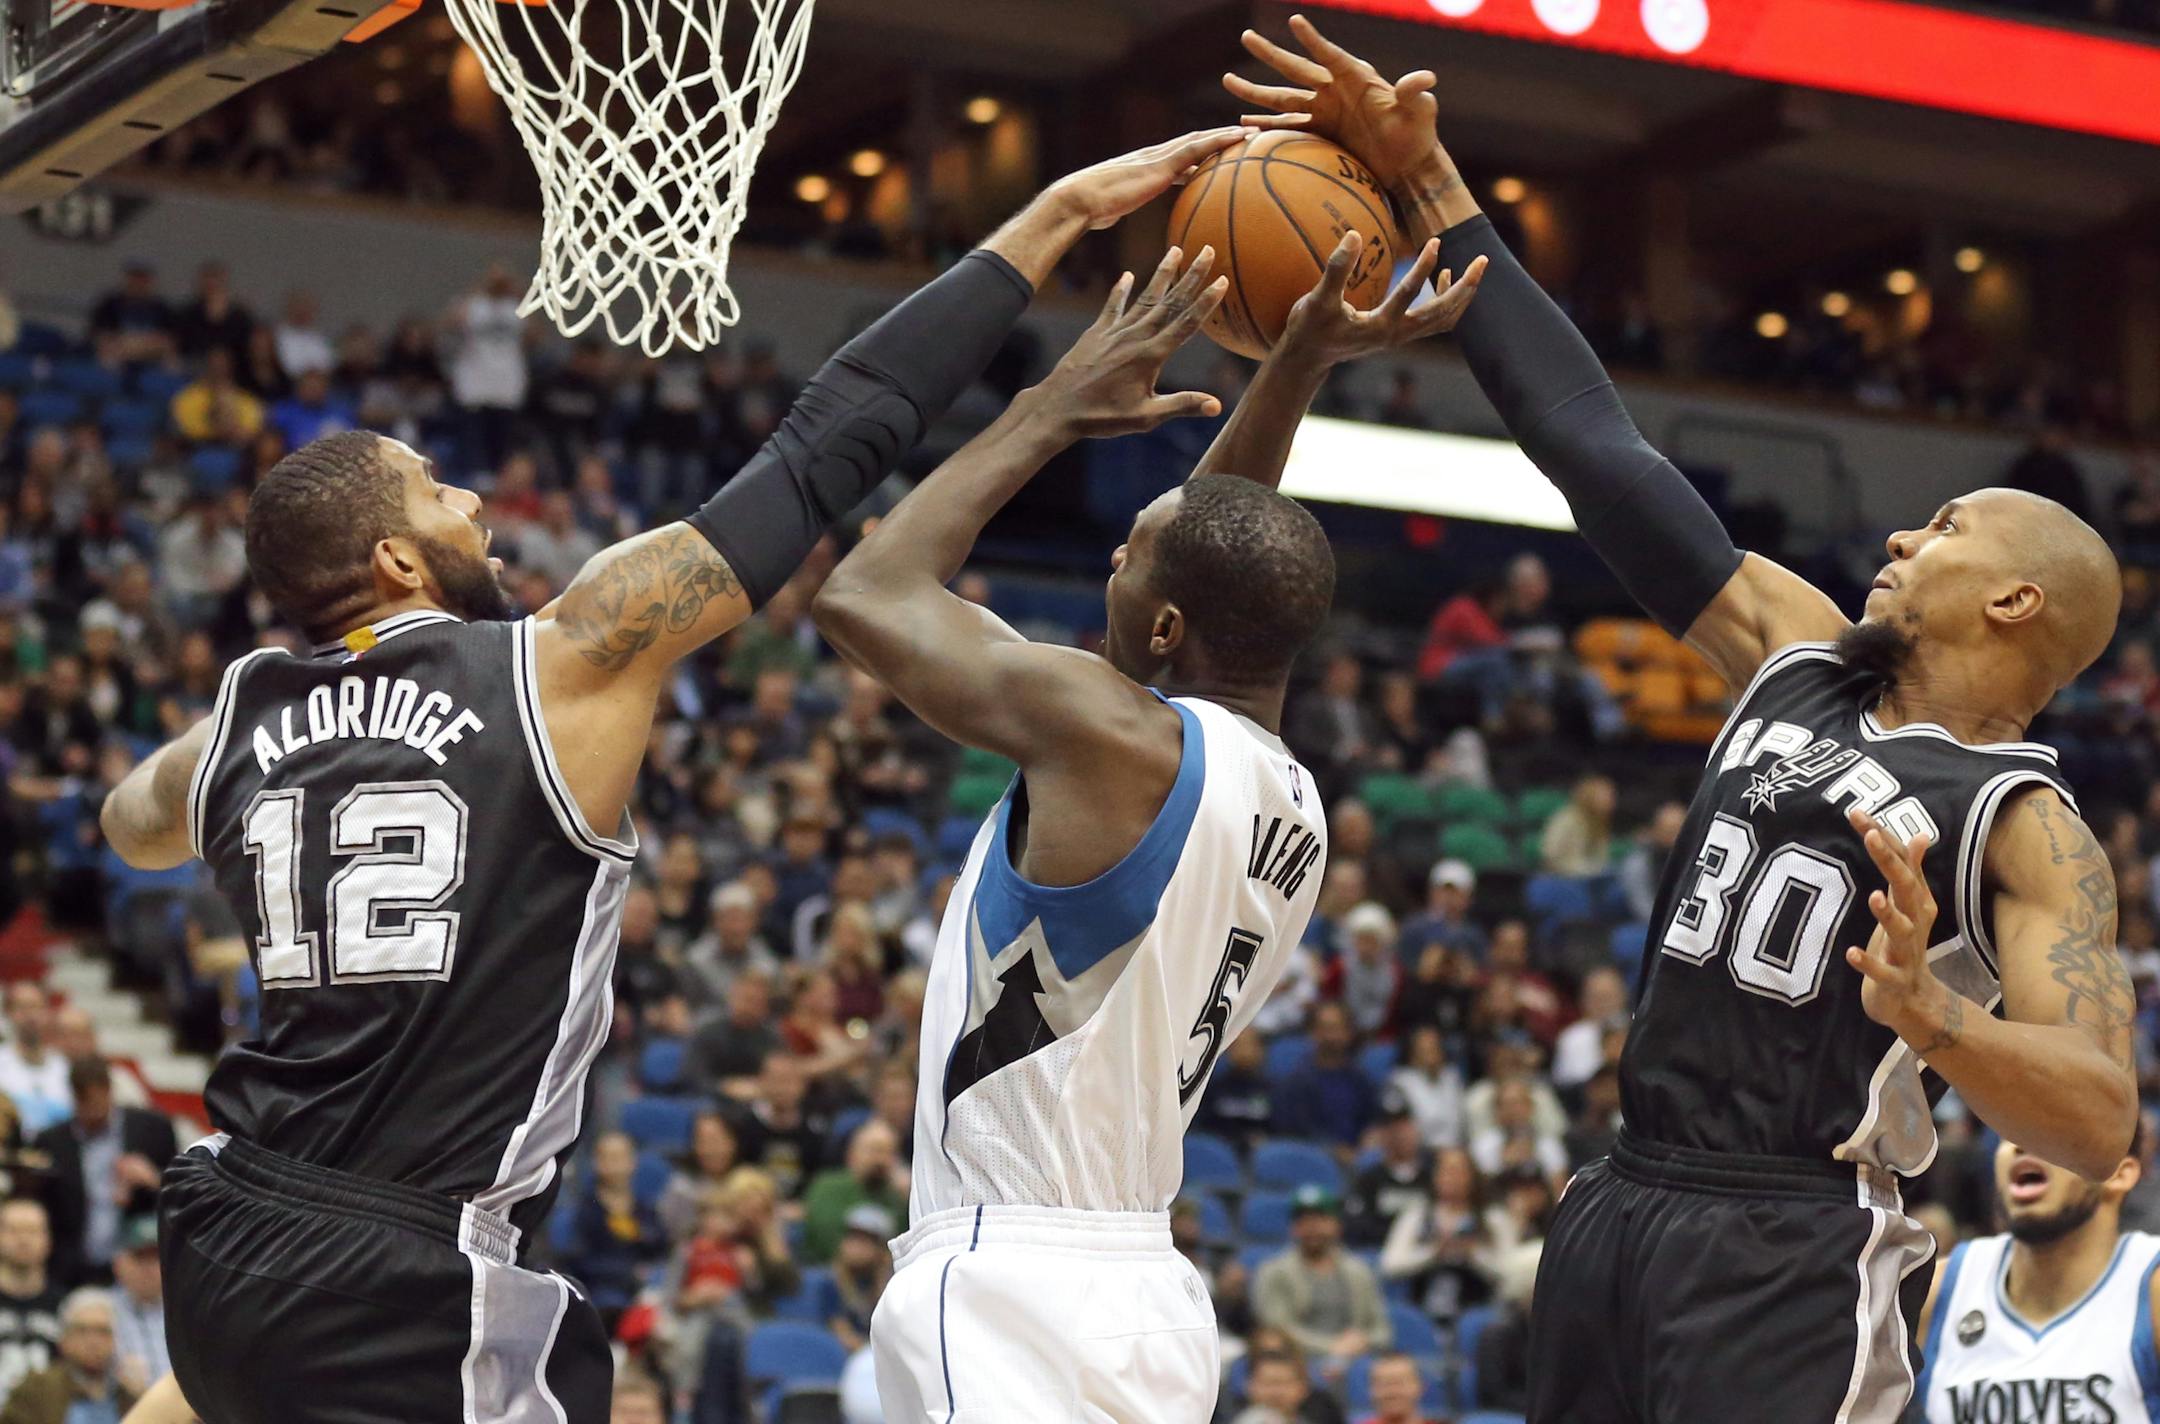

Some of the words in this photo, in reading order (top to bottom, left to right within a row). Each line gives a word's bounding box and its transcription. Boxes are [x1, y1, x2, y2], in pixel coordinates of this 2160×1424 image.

[252, 676, 485, 776] ALDRIDGE
[242, 779, 469, 990] 12
[1247, 813, 1322, 902] DIENG
[1661, 811, 1857, 1007] 30
[1177, 926, 1265, 1110] 5
[1945, 1373, 2118, 1424] WOLVES
